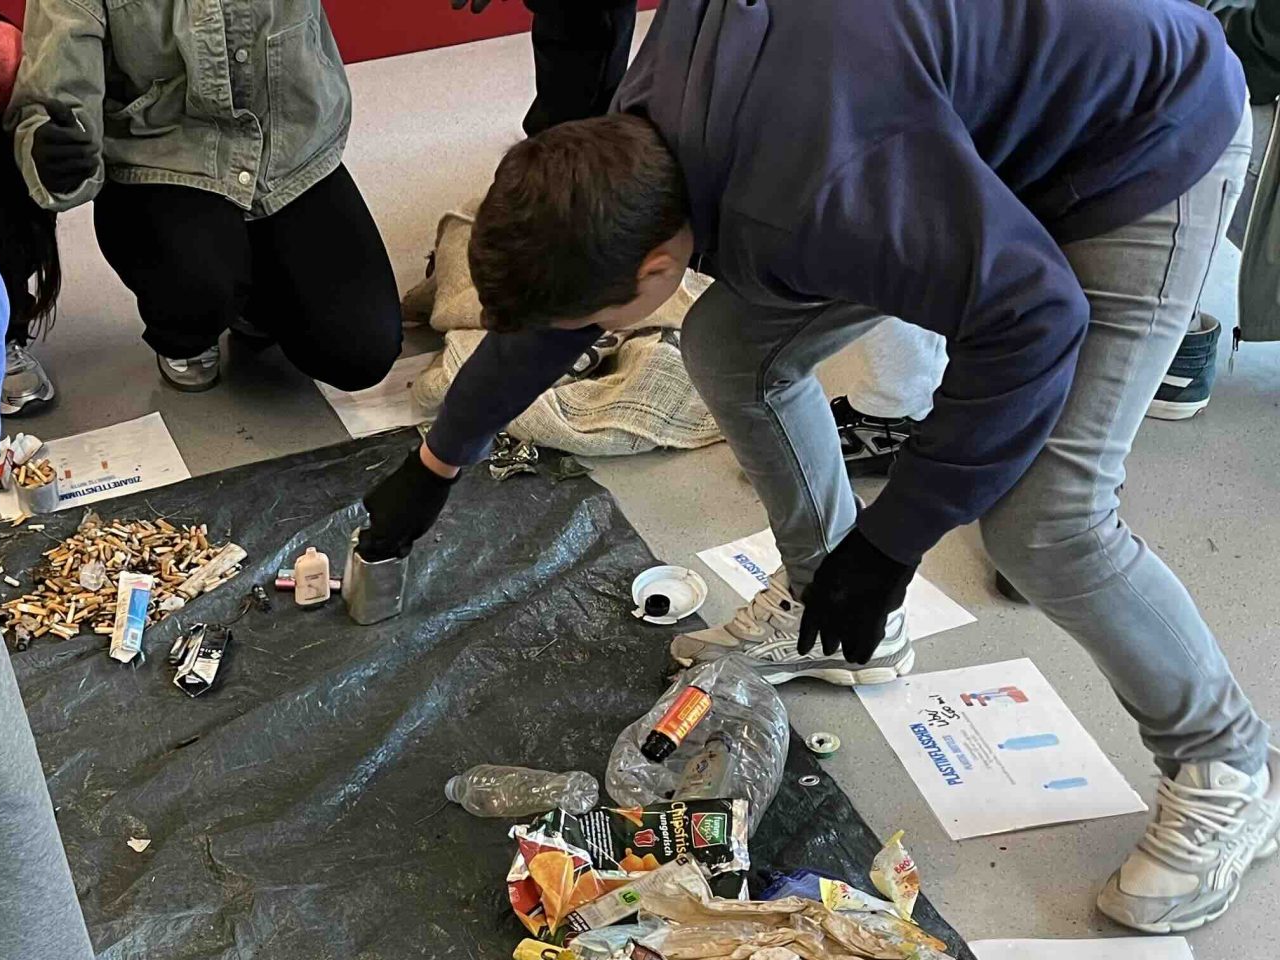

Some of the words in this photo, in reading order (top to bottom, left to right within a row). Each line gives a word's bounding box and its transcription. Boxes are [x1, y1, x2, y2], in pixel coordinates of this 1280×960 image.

[59, 475, 142, 500] ZIGARETTENSTUMM
[909, 722, 963, 786] PLASTIKFLASCHEN
[659, 812, 673, 856] ungarisch
[670, 801, 688, 859] Chipsfrisc
